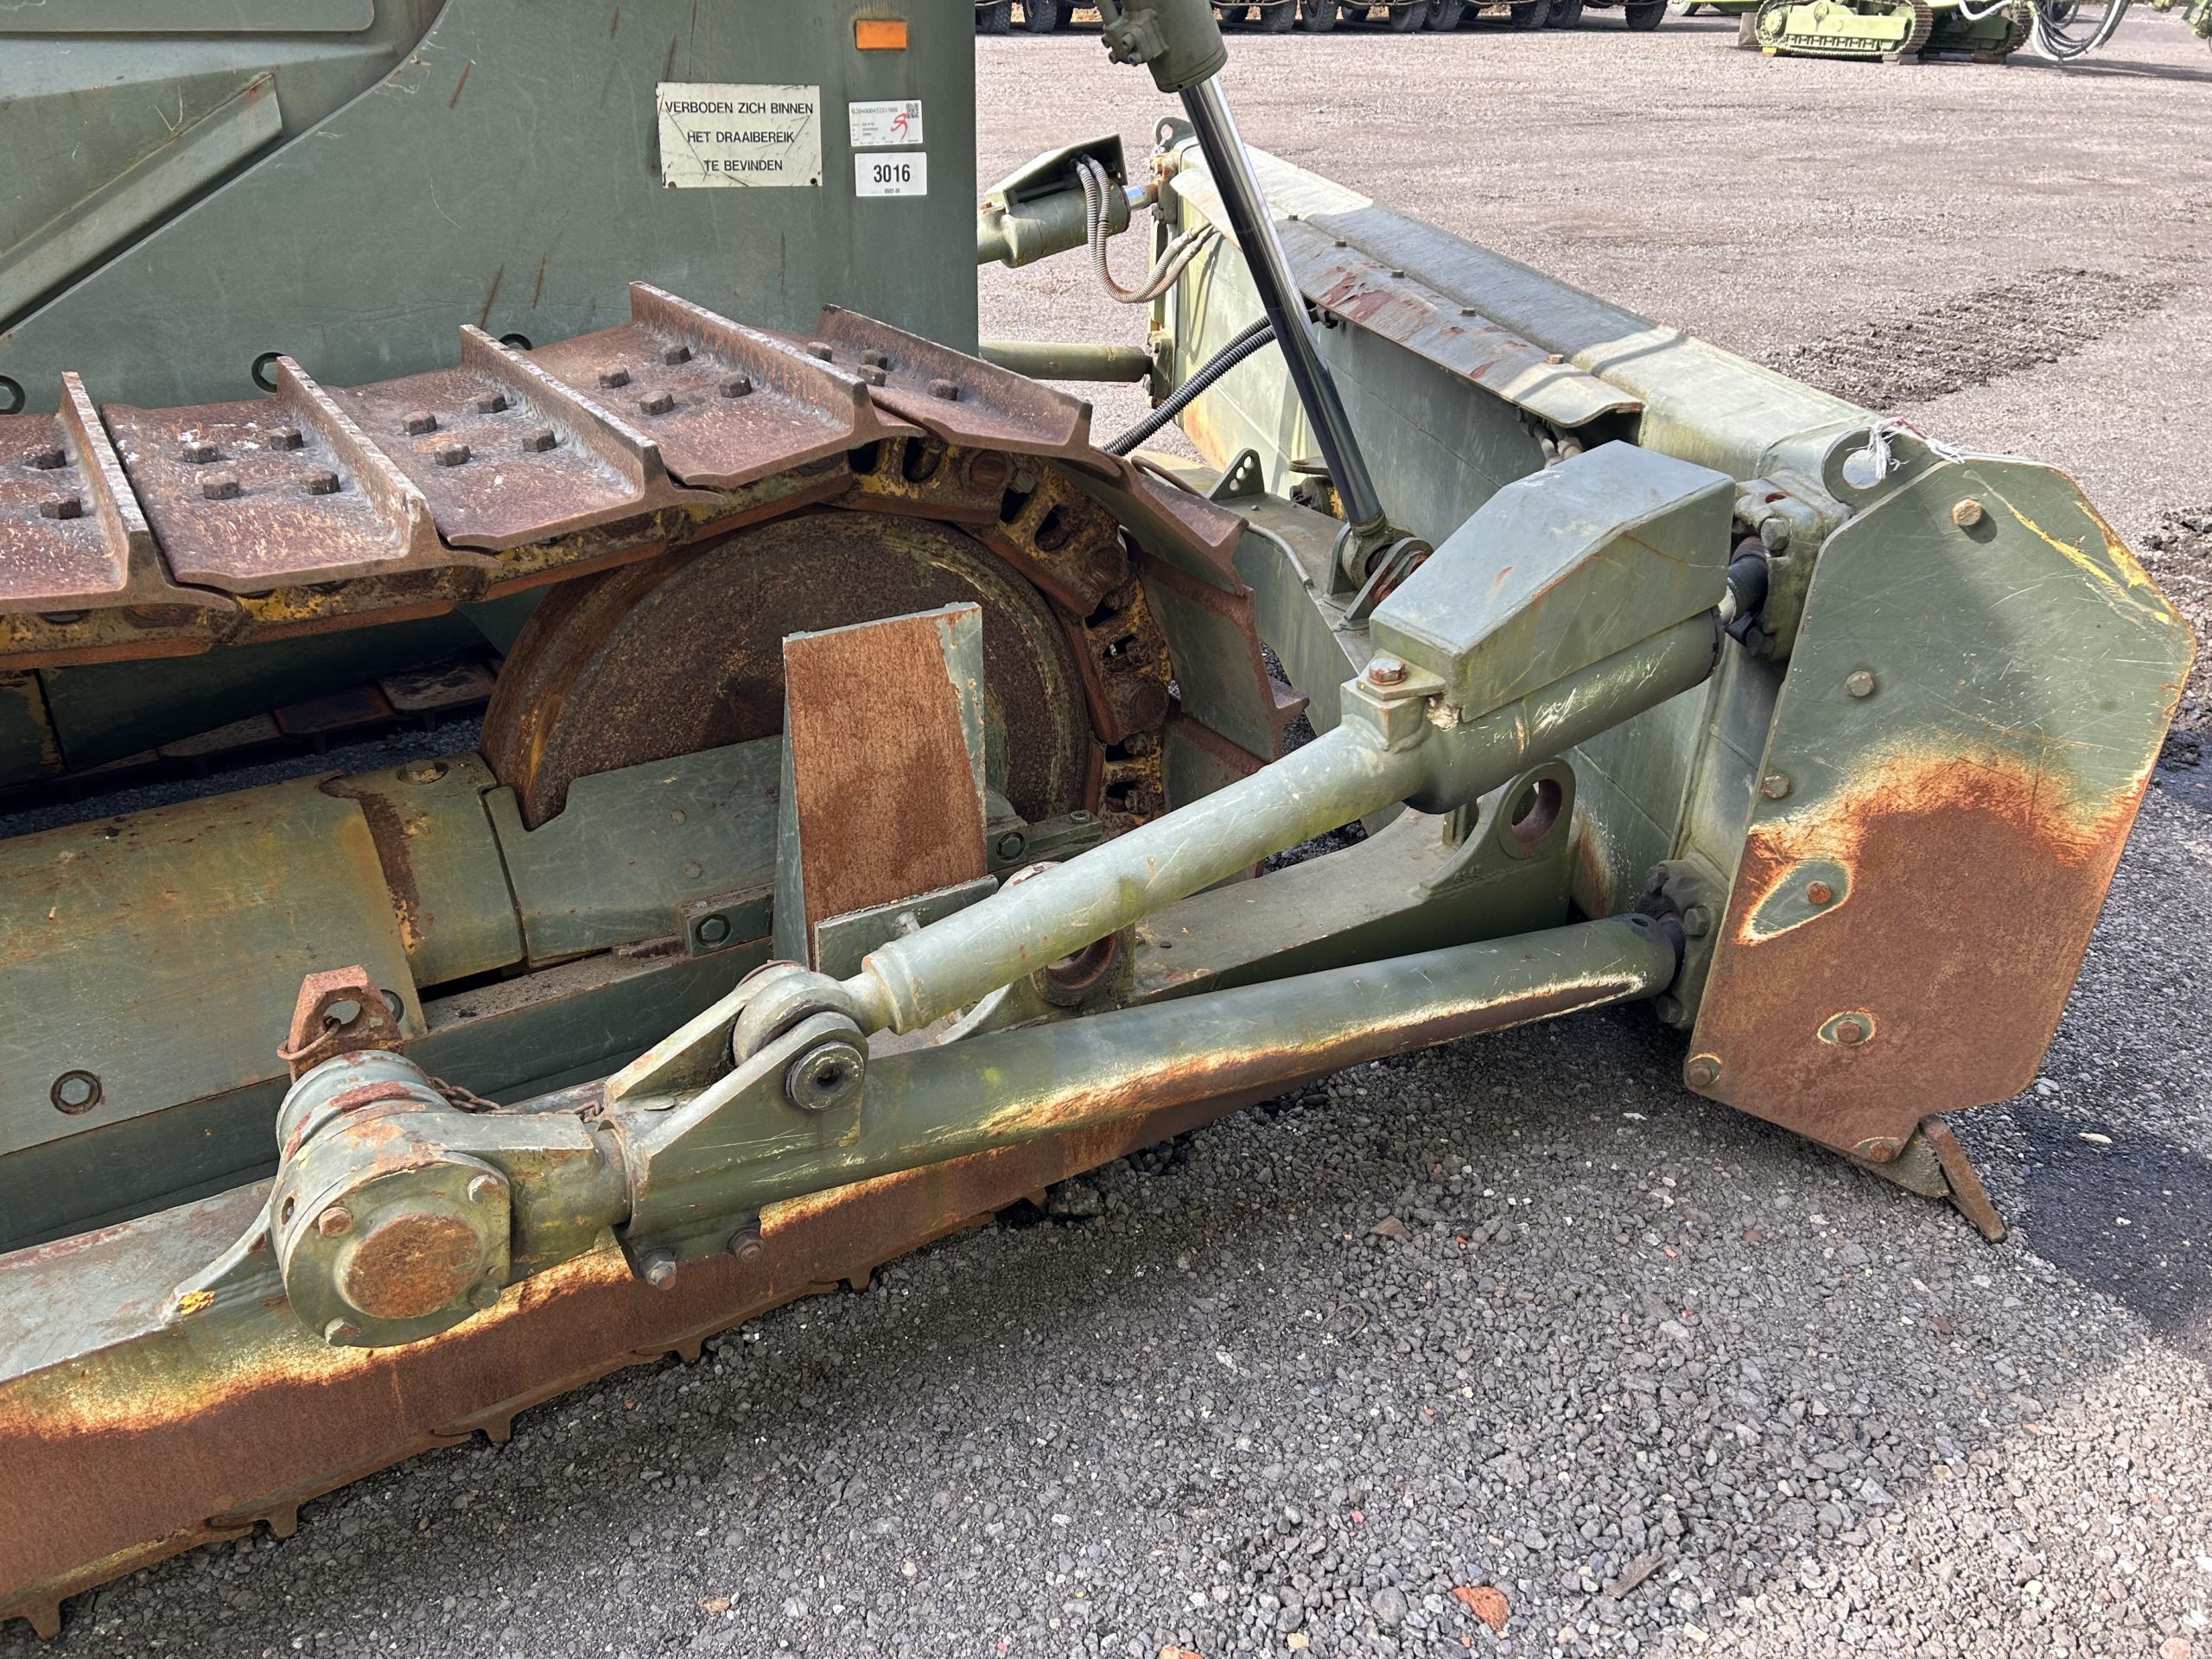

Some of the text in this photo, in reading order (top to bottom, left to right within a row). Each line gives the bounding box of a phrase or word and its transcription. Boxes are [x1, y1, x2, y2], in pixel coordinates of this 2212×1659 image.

[664, 101, 813, 114] VERBODEN ZICH BINNEN
[687, 131, 795, 143] HET DRAAIBEREIK
[705, 160, 783, 171] TE BEVINDEN
[874, 164, 911, 182] 3016
